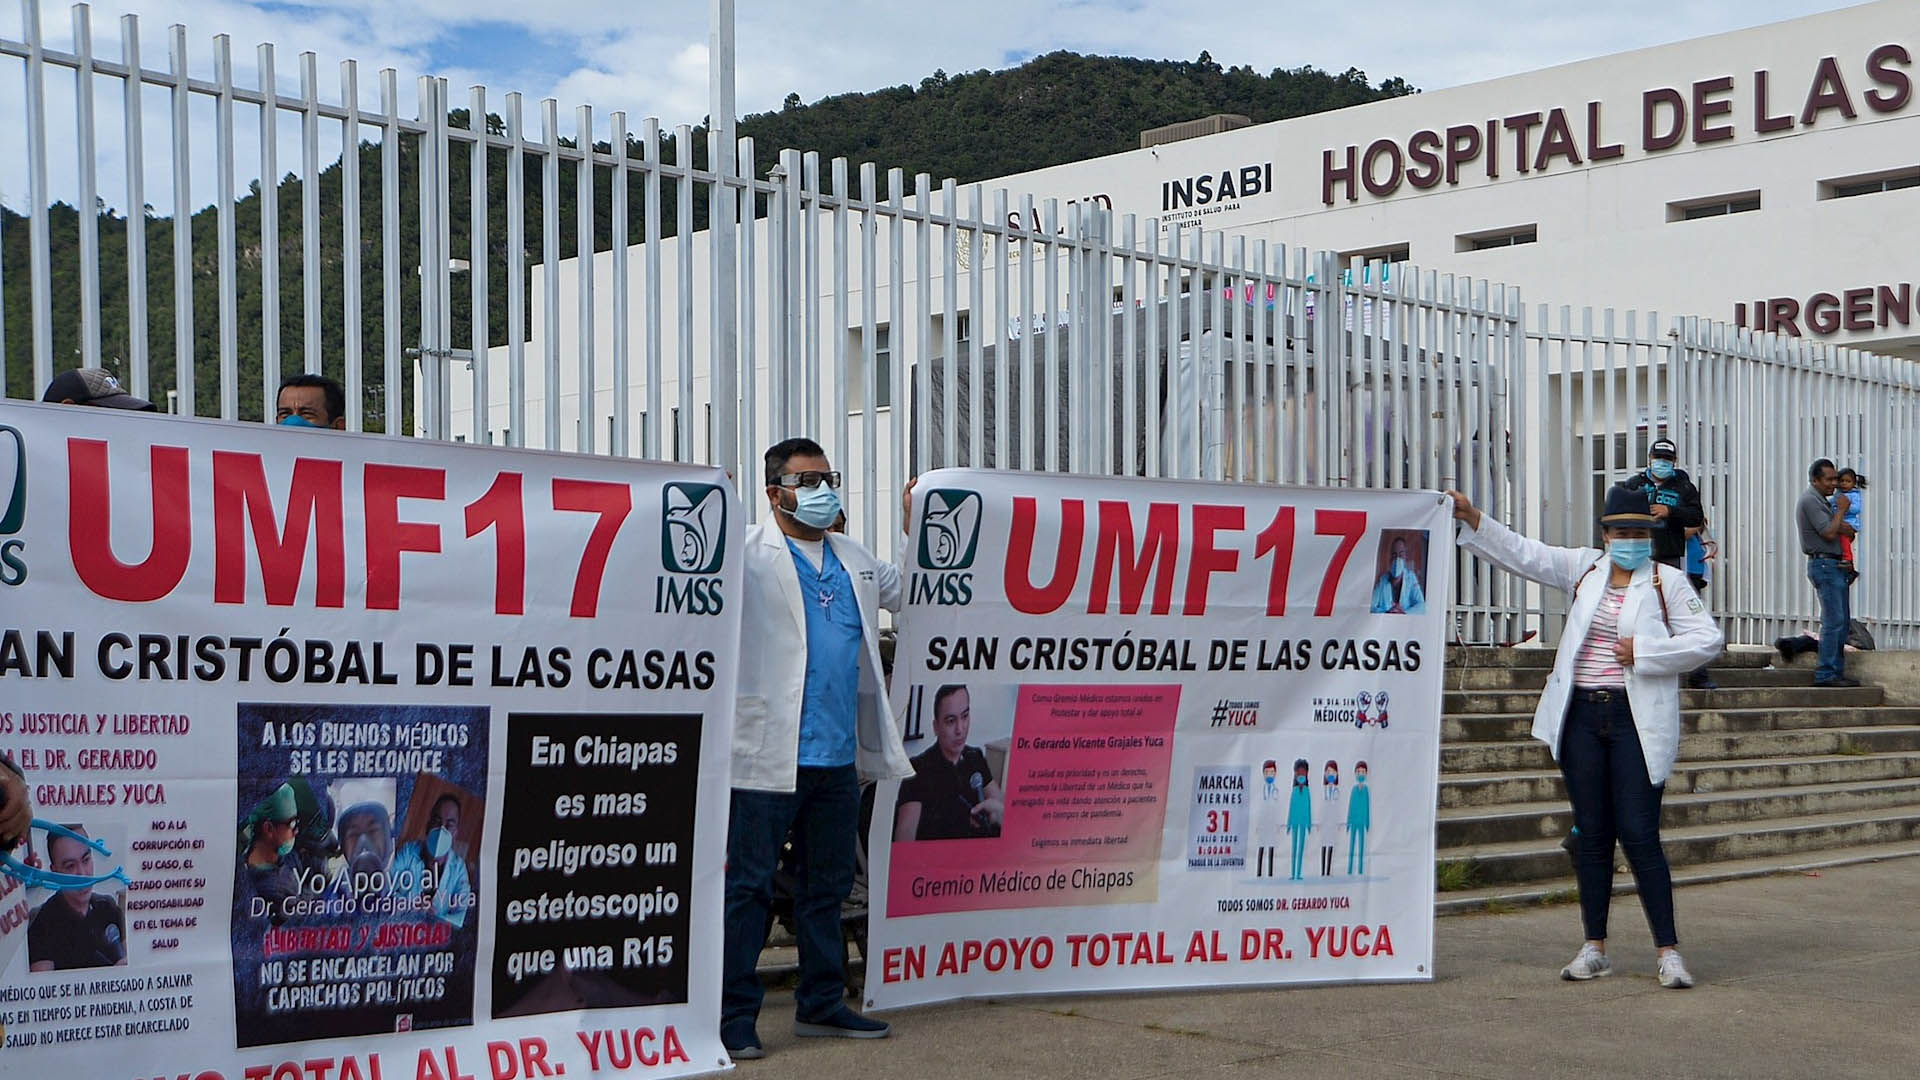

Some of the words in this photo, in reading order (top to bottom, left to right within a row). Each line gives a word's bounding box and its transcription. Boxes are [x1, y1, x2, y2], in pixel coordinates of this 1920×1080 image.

[1322, 101, 1624, 203] HOSPITAL
[1642, 76, 1734, 151] DE
[1754, 44, 1912, 132] LAS
[1162, 162, 1272, 211] INSABI
[1161, 210, 1193, 222] INSTITUTO
[1203, 206, 1222, 215] SALUD
[1224, 203, 1241, 211] PARA
[1735, 282, 1920, 339] URGEN
[66, 436, 633, 618] UMF17
[1003, 495, 1368, 617] UMF17
[655, 574, 725, 616] IMSS
[908, 572, 973, 606] IMSS
[0, 629, 76, 679] AN
[98, 626, 398, 685] CRISTÓBAL
[416, 642, 474, 686] DE
[491, 645, 572, 688] LAS
[587, 647, 716, 691] CASAS
[925, 636, 999, 671] SAN
[1009, 630, 1198, 672] CRISTÓBAL
[1207, 639, 1247, 672] DE
[1256, 639, 1312, 672] LAS
[1320, 638, 1422, 673] CASAS
[19, 713, 90, 735] JUSTICIA
[96, 713, 108, 735] Y
[112, 713, 190, 736] LIBERTAD
[1313, 707, 1355, 723] MÉDICOS
[262, 721, 276, 746] A
[281, 722, 316, 746] LOS
[321, 721, 390, 746] BUENOS
[395, 720, 469, 749] MÉDICOS
[1033, 737, 1071, 749] Gerardo
[1108, 735, 1142, 750] Grajales
[1145, 736, 1164, 747] Yuca
[21, 749, 40, 770] EL
[45, 749, 71, 770] DR.
[78, 749, 158, 772] GERARDO
[290, 750, 311, 773] SE
[317, 750, 348, 774] LES
[353, 750, 443, 773] RECONOCE
[531, 735, 566, 765] En
[574, 735, 678, 770] Chiapas
[36, 784, 115, 806] GRAJALES
[122, 784, 167, 805] YUCA
[1199, 775, 1244, 790] MARCHA
[555, 794, 585, 818] es
[592, 792, 647, 815] mas
[1197, 793, 1242, 804] VIERNES
[152, 820, 166, 830] NO
[167, 820, 175, 830] A
[176, 820, 187, 830] LA
[1206, 810, 1230, 833] 31
[141, 861, 154, 870] SU
[155, 860, 182, 870] CASO,
[183, 859, 193, 869] EL
[512, 840, 638, 877] peligroso
[645, 841, 677, 865] un
[128, 880, 162, 891] ESTADO
[164, 879, 192, 889] OMITE
[194, 878, 206, 887] SU
[292, 866, 326, 895] Yo
[333, 865, 413, 899] Apoyo
[420, 862, 439, 889] al
[911, 875, 974, 898] Gremio
[979, 871, 1041, 895] Médico
[1046, 869, 1067, 890] de
[1071, 868, 1134, 893] Chiapas
[250, 897, 276, 917] Dr.
[282, 894, 357, 916] Gerardo
[362, 891, 431, 916] Grajales
[438, 891, 477, 908] Yuca
[506, 886, 680, 923] estetoscopio
[1217, 899, 1243, 912] TODOS
[1246, 899, 1274, 912] SOMOS
[1276, 898, 1289, 910] DR.
[1292, 896, 1328, 910] GERARDO
[1330, 896, 1350, 909] YUCA
[148, 919, 158, 929] EL
[160, 918, 184, 929] TEMA
[185, 918, 197, 926] DE
[152, 938, 180, 949] SALUD
[507, 949, 555, 981] que
[563, 945, 614, 971] una
[622, 935, 674, 968] R15
[882, 941, 926, 985] EN
[936, 935, 1054, 976] APOYO
[1066, 931, 1174, 967] TOTAL
[1185, 929, 1228, 963] AL
[1239, 927, 1292, 961] DR.
[1304, 924, 1395, 958] YUCA
[261, 960, 283, 985] NO
[288, 959, 307, 983] SE
[312, 953, 421, 980] ENCARCELAN
[424, 952, 454, 974] POR
[0, 985, 36, 1001] MÉDICO
[38, 985, 57, 999] QUE
[60, 983, 72, 997] SE
[74, 982, 87, 996] HA
[147, 977, 154, 989] A
[156, 973, 193, 989] SALVAR
[268, 982, 360, 1010] CAPRICHOS
[365, 977, 446, 1003] POLÍTICOS
[17, 1010, 30, 1023] EN
[32, 1006, 72, 1022] TIEMPOS
[74, 1004, 87, 1018] DE
[138, 999, 146, 1012] A
[147, 996, 177, 1012] COSTA
[180, 995, 193, 1008] DE
[6, 1031, 37, 1049] SALUD
[40, 1030, 53, 1044] NO
[56, 1026, 93, 1043] MERECE
[95, 1023, 122, 1038] ESTAR
[125, 1017, 190, 1036] ENCARCELADO
[415, 1045, 476, 1080] AL
[486, 1037, 566, 1079] DR.
[576, 1024, 691, 1071] YUCA
